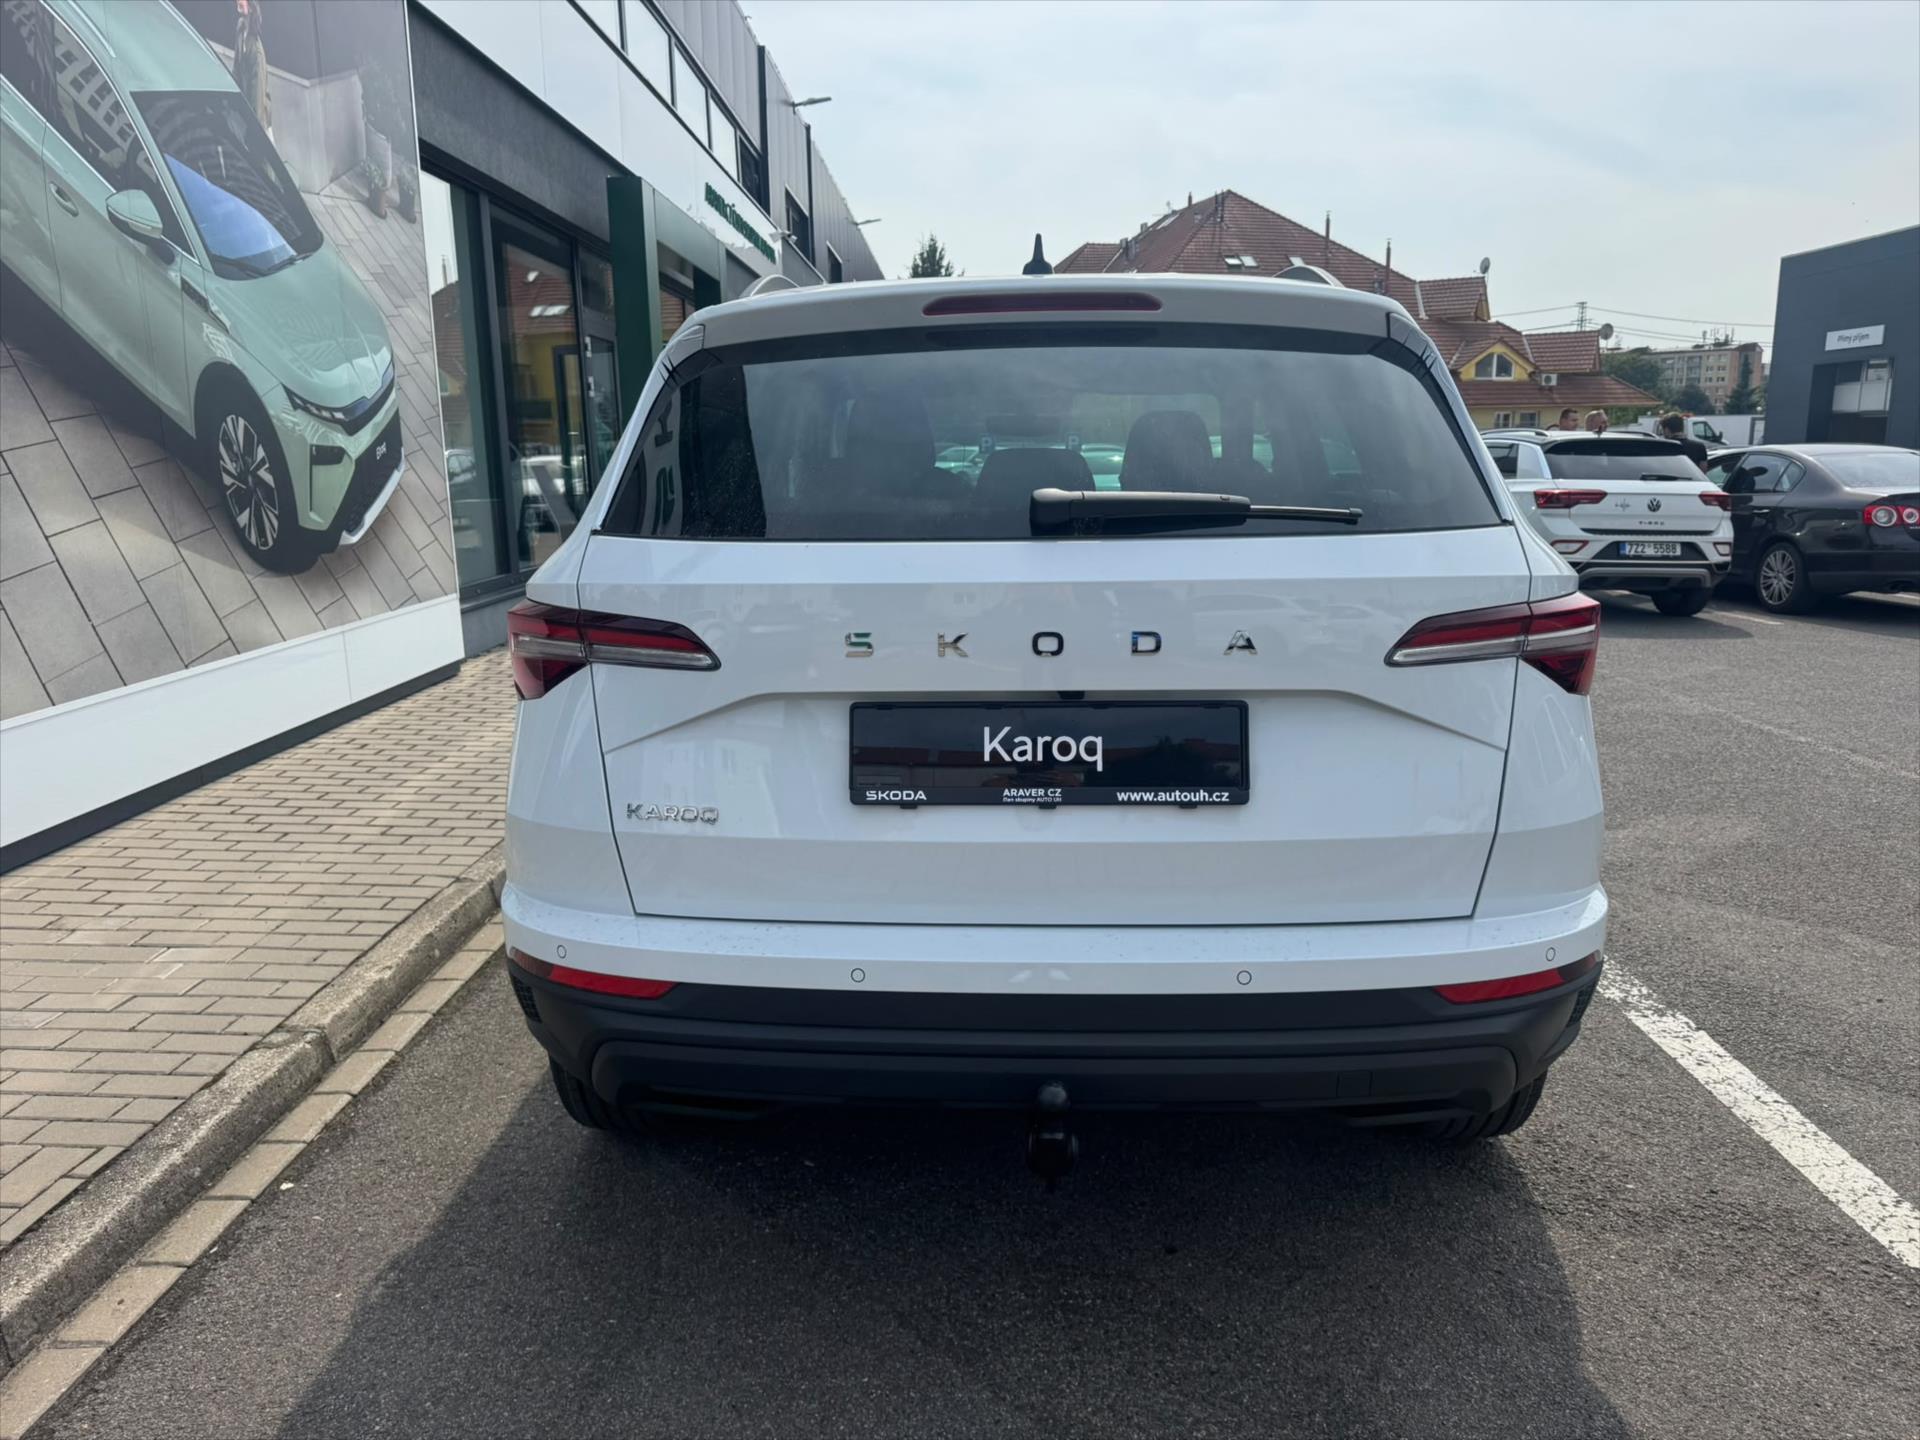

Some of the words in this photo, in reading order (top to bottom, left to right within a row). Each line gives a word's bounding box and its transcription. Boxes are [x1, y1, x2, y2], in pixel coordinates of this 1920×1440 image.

[1653, 543, 1677, 554] 5588
[983, 726, 1103, 772] Karoq
[1003, 788, 1045, 797] ARAVER
[1047, 788, 1062, 797] CZ
[1116, 789, 1230, 802] www.autouh.cz
[626, 803, 719, 825] KAROQ
